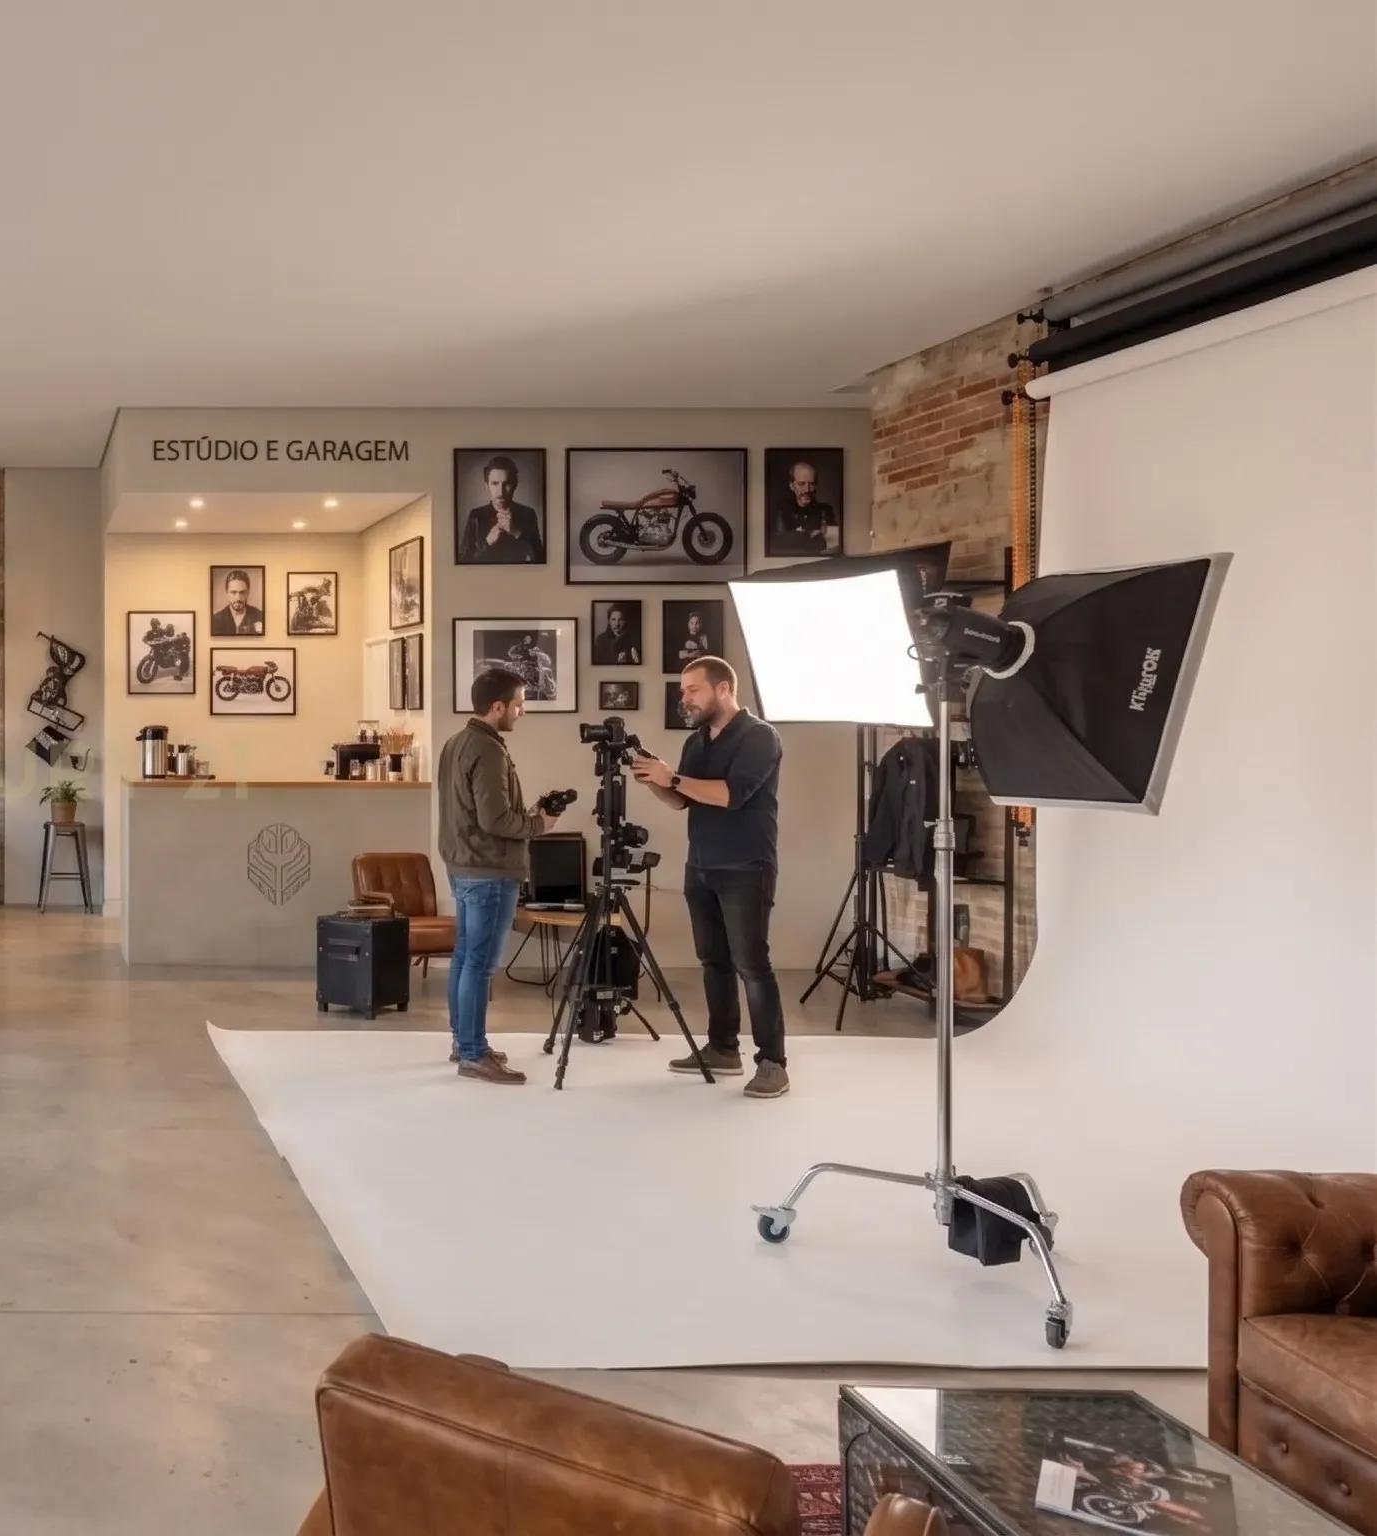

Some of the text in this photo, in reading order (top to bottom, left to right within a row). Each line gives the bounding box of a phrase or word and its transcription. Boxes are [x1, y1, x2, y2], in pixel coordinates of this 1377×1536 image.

[153, 436, 409, 461] ESTÚDIO E GARAGEM
